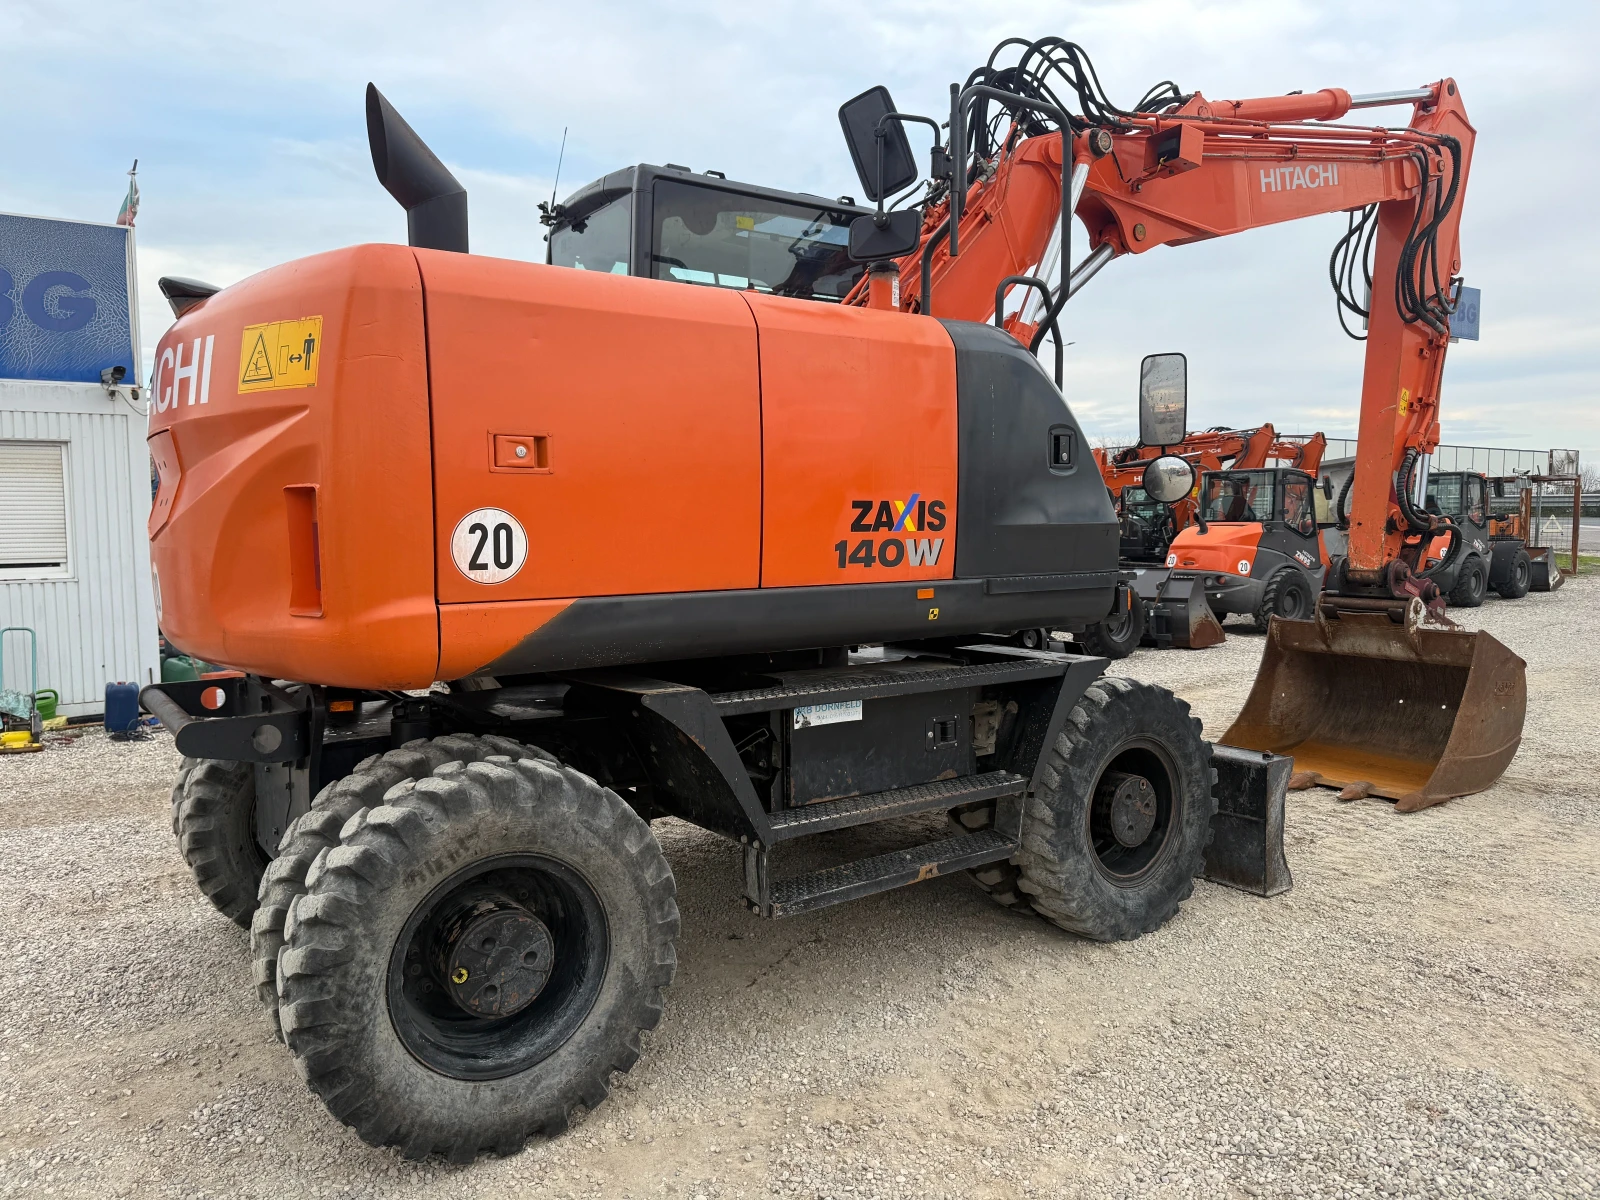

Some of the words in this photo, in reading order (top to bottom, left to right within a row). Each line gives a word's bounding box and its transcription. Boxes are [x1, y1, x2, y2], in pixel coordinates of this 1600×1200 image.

[1259, 163, 1339, 193] HITACHI
[0, 266, 98, 332] G
[850, 492, 947, 533] ZAXIS
[468, 522, 514, 571] 20
[834, 538, 945, 569] 140W
[1240, 562, 1248, 571] 20
[815, 700, 862, 713] DORNFELD
